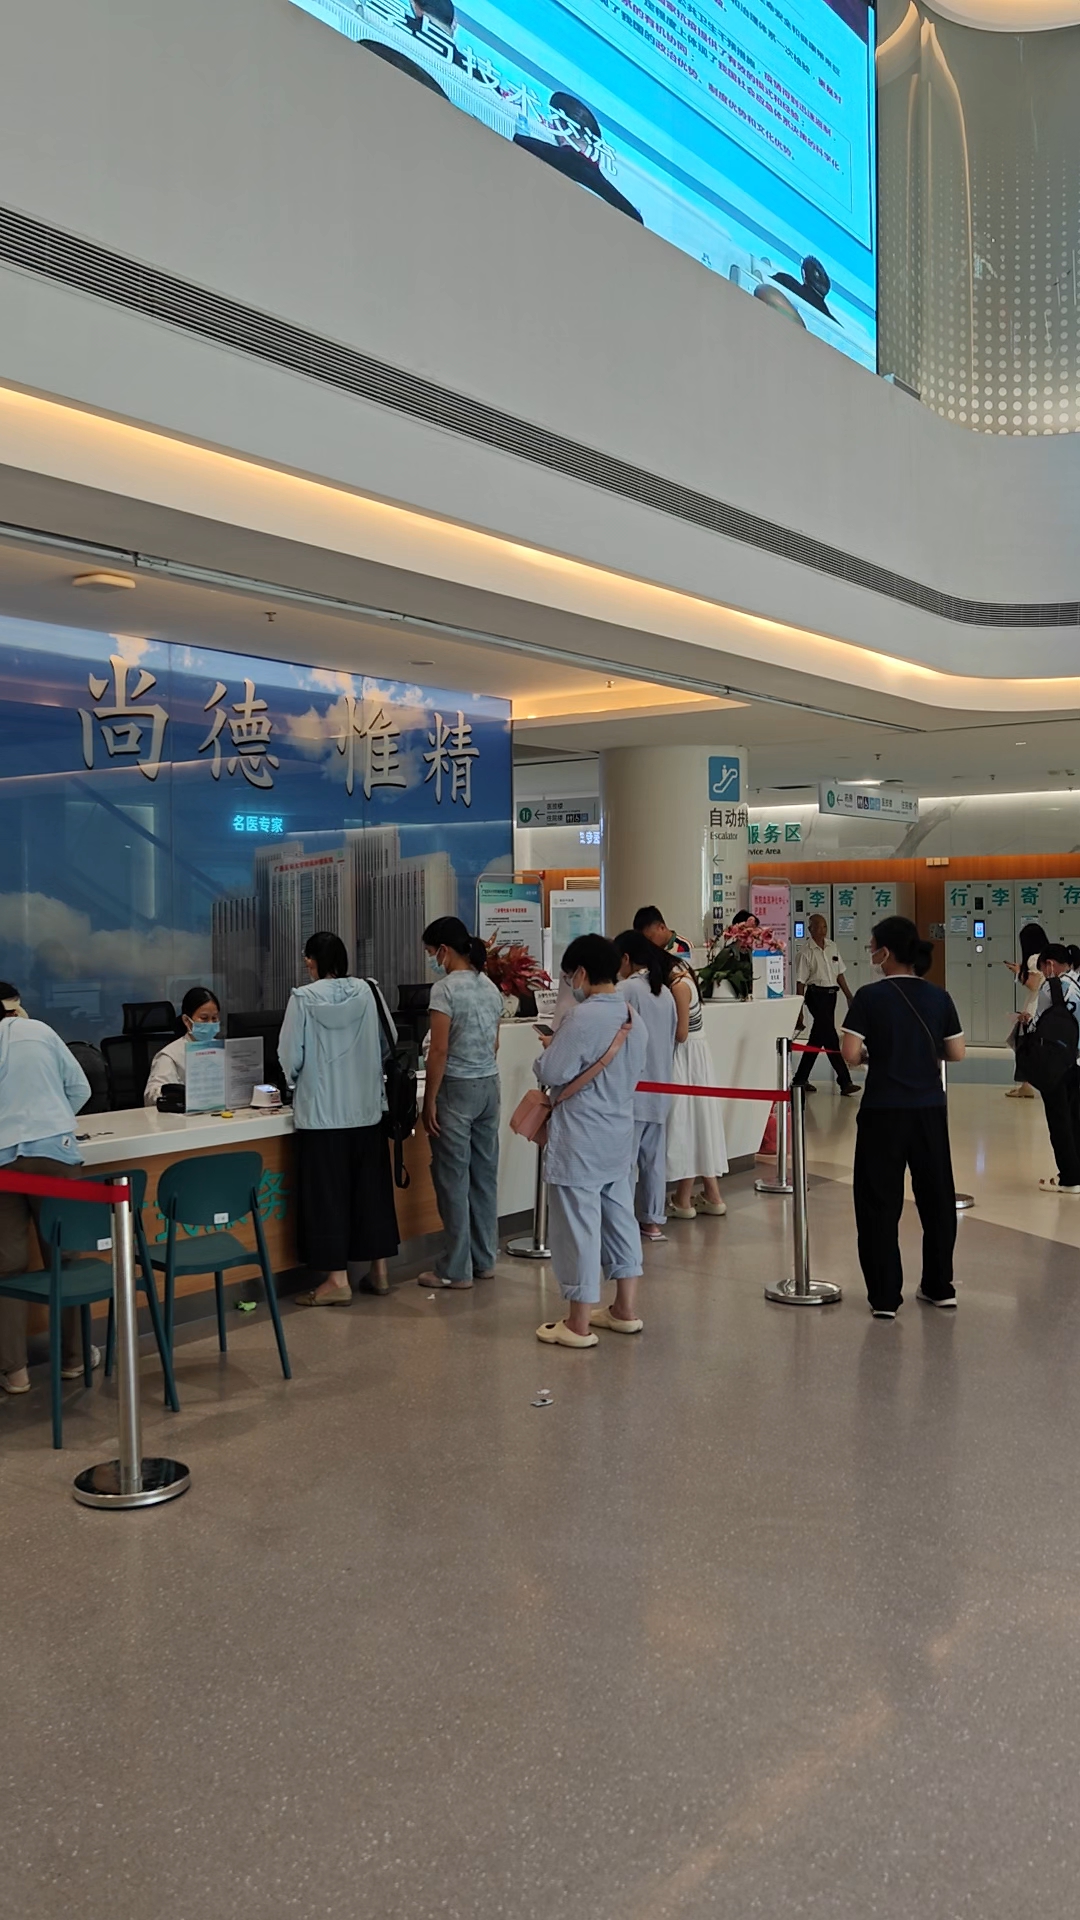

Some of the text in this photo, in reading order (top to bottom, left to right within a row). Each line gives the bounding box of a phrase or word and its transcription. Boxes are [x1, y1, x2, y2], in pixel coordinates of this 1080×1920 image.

[354, 0, 617, 175] 享与技术交流
[77, 653, 481, 808] 尚德 惟精
[233, 815, 283, 833] 名医专家
[709, 808, 748, 828] 自动扶
[710, 831, 738, 840] Escalator
[748, 822, 802, 844] 服务区
[950, 886, 1080, 906] 行李寄存
